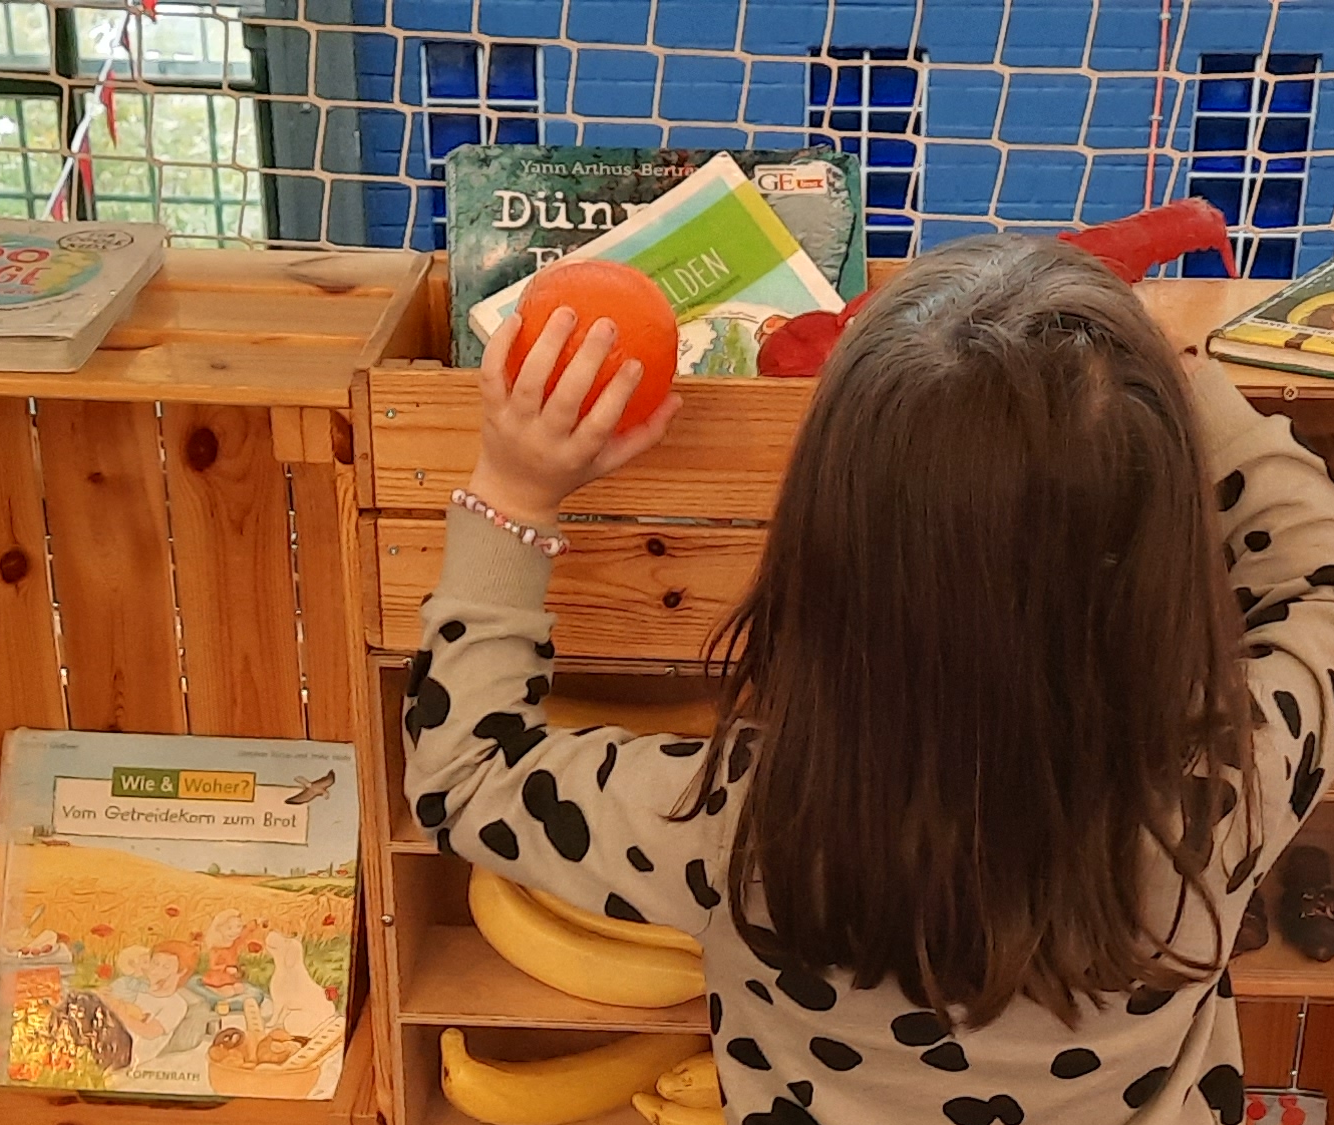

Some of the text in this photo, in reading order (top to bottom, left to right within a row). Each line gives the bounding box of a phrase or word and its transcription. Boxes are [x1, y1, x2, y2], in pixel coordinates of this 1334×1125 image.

[519, 160, 698, 177] Yann Arthus-Bertra
[653, 246, 730, 309] LDEN
[120, 775, 251, 796] Wie & Woher?
[62, 804, 97, 820] Vom
[223, 813, 255, 826] zum
[263, 811, 298, 829] Brot
[126, 1069, 201, 1082] COPPENRATH
